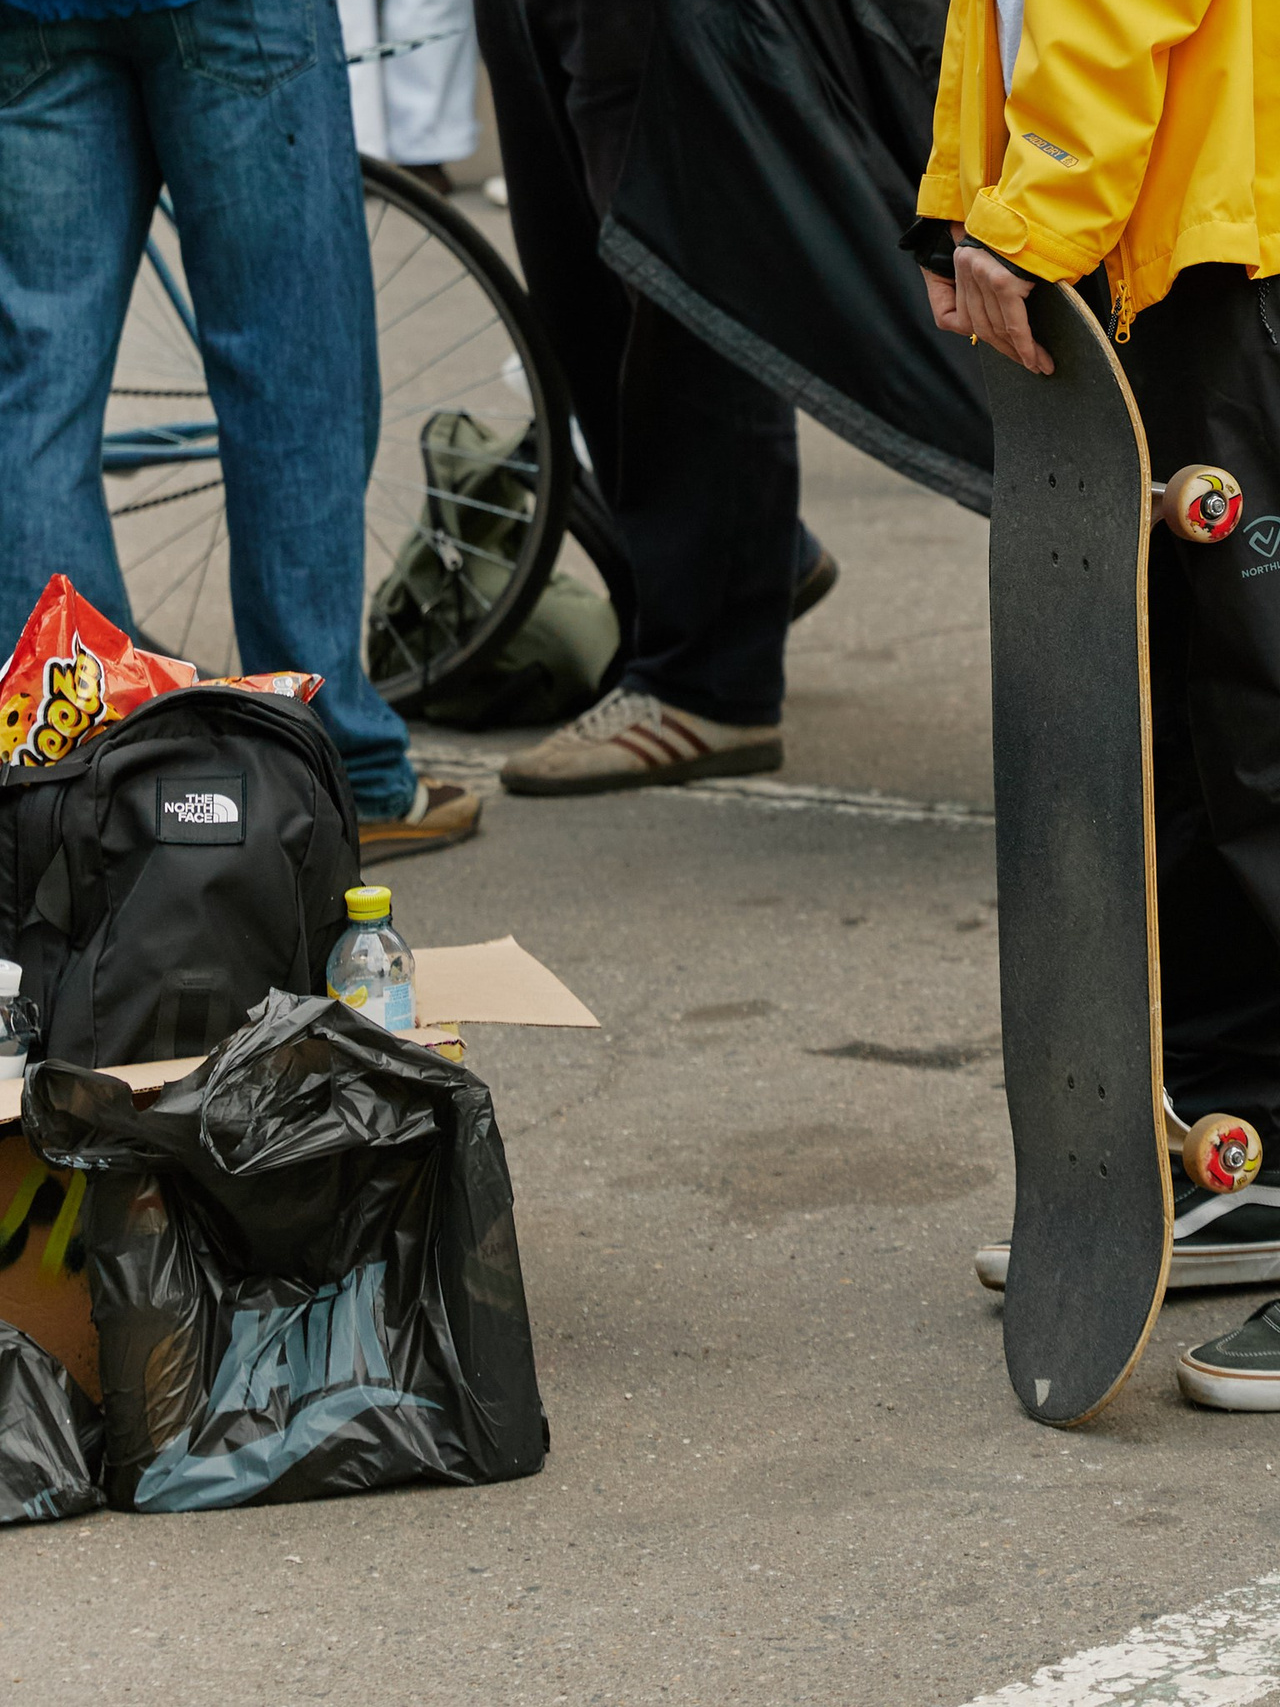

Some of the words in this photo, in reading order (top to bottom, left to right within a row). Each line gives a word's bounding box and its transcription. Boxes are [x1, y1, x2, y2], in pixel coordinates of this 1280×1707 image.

[185, 793, 213, 804] THE
[164, 802, 213, 814] NORTH
[178, 812, 213, 824] FACE
